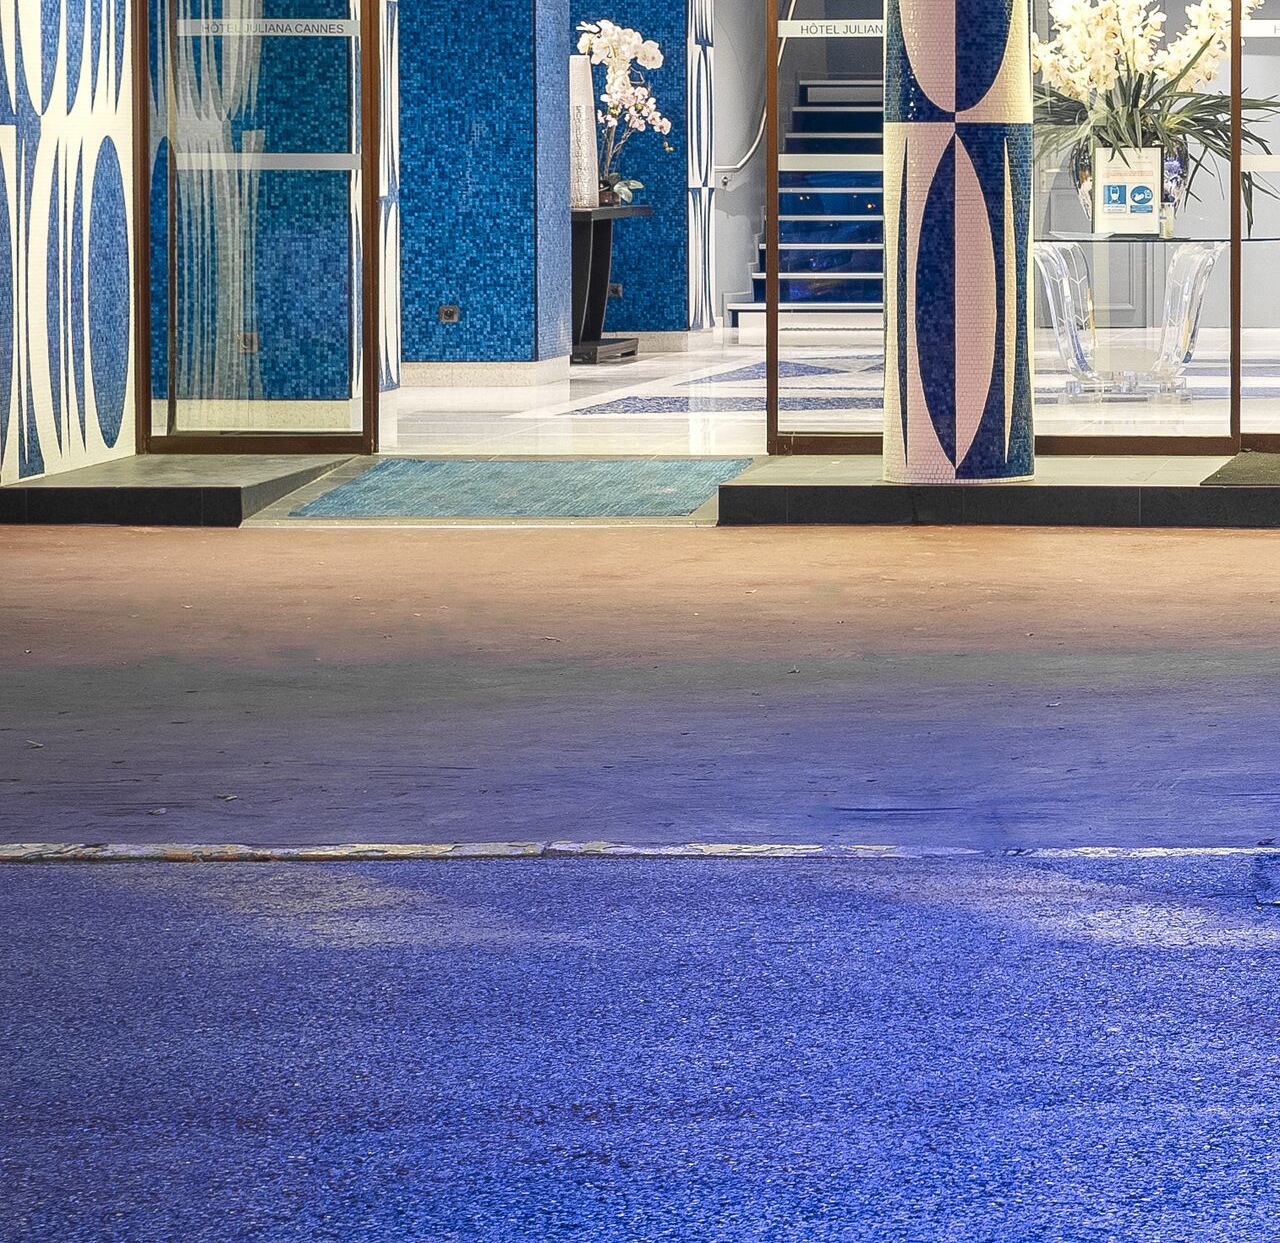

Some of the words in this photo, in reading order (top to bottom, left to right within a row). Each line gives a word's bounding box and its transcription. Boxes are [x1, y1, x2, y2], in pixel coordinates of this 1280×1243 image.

[244, 23, 292, 34] JULIANA
[294, 23, 344, 34] CANNES
[800, 23, 840, 35] HÔTEL
[842, 24, 883, 35] JULIAN
